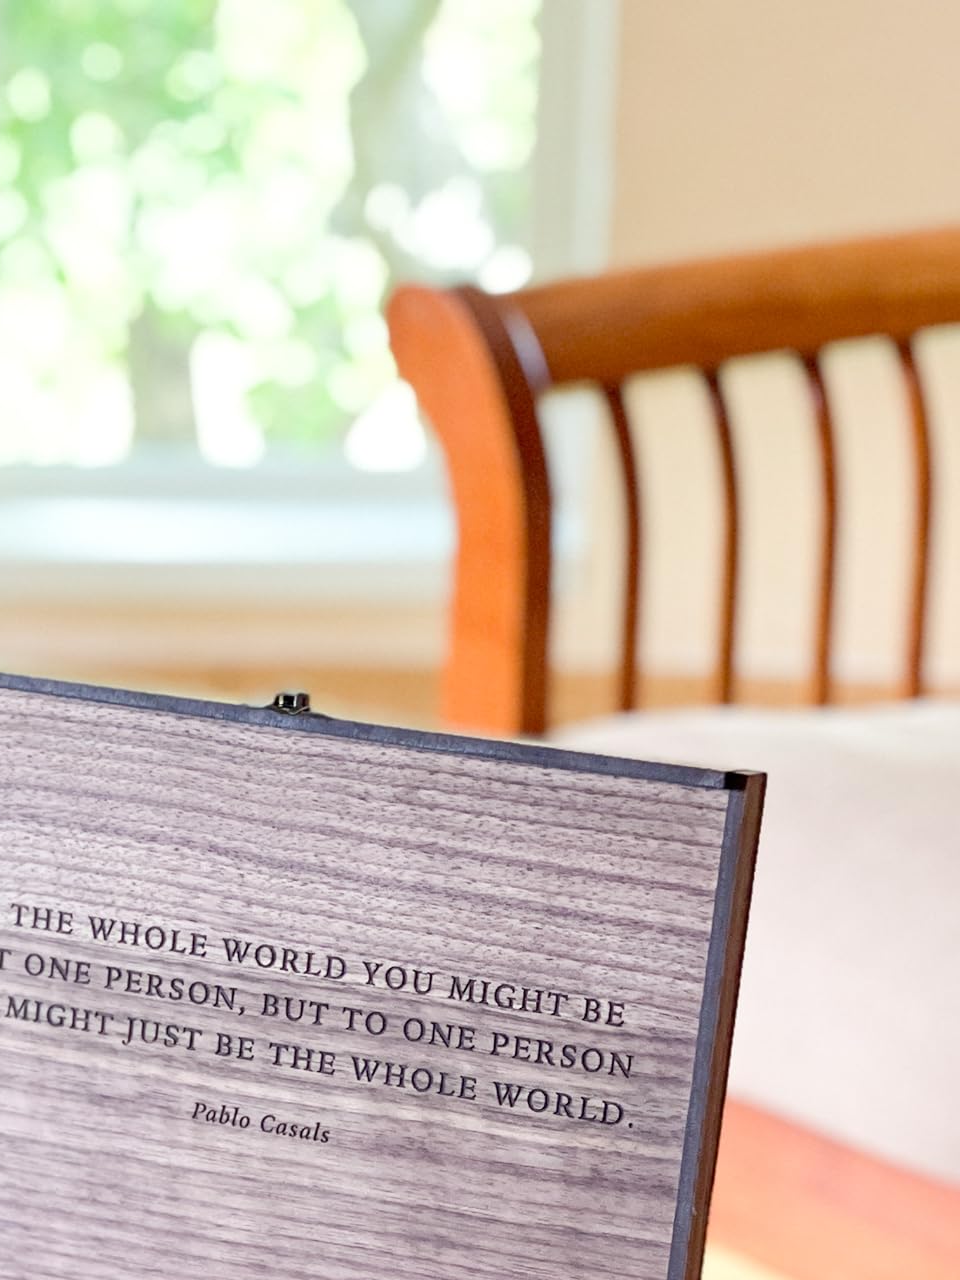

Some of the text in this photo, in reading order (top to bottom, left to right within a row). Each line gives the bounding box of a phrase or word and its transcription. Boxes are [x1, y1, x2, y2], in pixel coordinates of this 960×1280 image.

[10, 903, 74, 935] THE
[88, 915, 208, 958] WHOLE
[222, 937, 348, 981] WORLD
[361, 961, 435, 995] YOU
[448, 975, 571, 1018] MIGHT
[582, 997, 627, 1027] BE
[24, 953, 91, 985] ONE
[104, 966, 246, 1017] PERSON,
[261, 993, 331, 1027] BUT
[342, 1007, 388, 1036] TO
[402, 1017, 476, 1052] ONE
[489, 1033, 636, 1080] PERSON
[5, 995, 115, 1035] MIGHT
[121, 1016, 205, 1053] JUST
[214, 1033, 255, 1062] BE
[269, 1042, 337, 1076] THE
[351, 1058, 479, 1102] WHOLE
[493, 1082, 635, 1129] WORLD.
[191, 1100, 331, 1145] Pablo Casals
